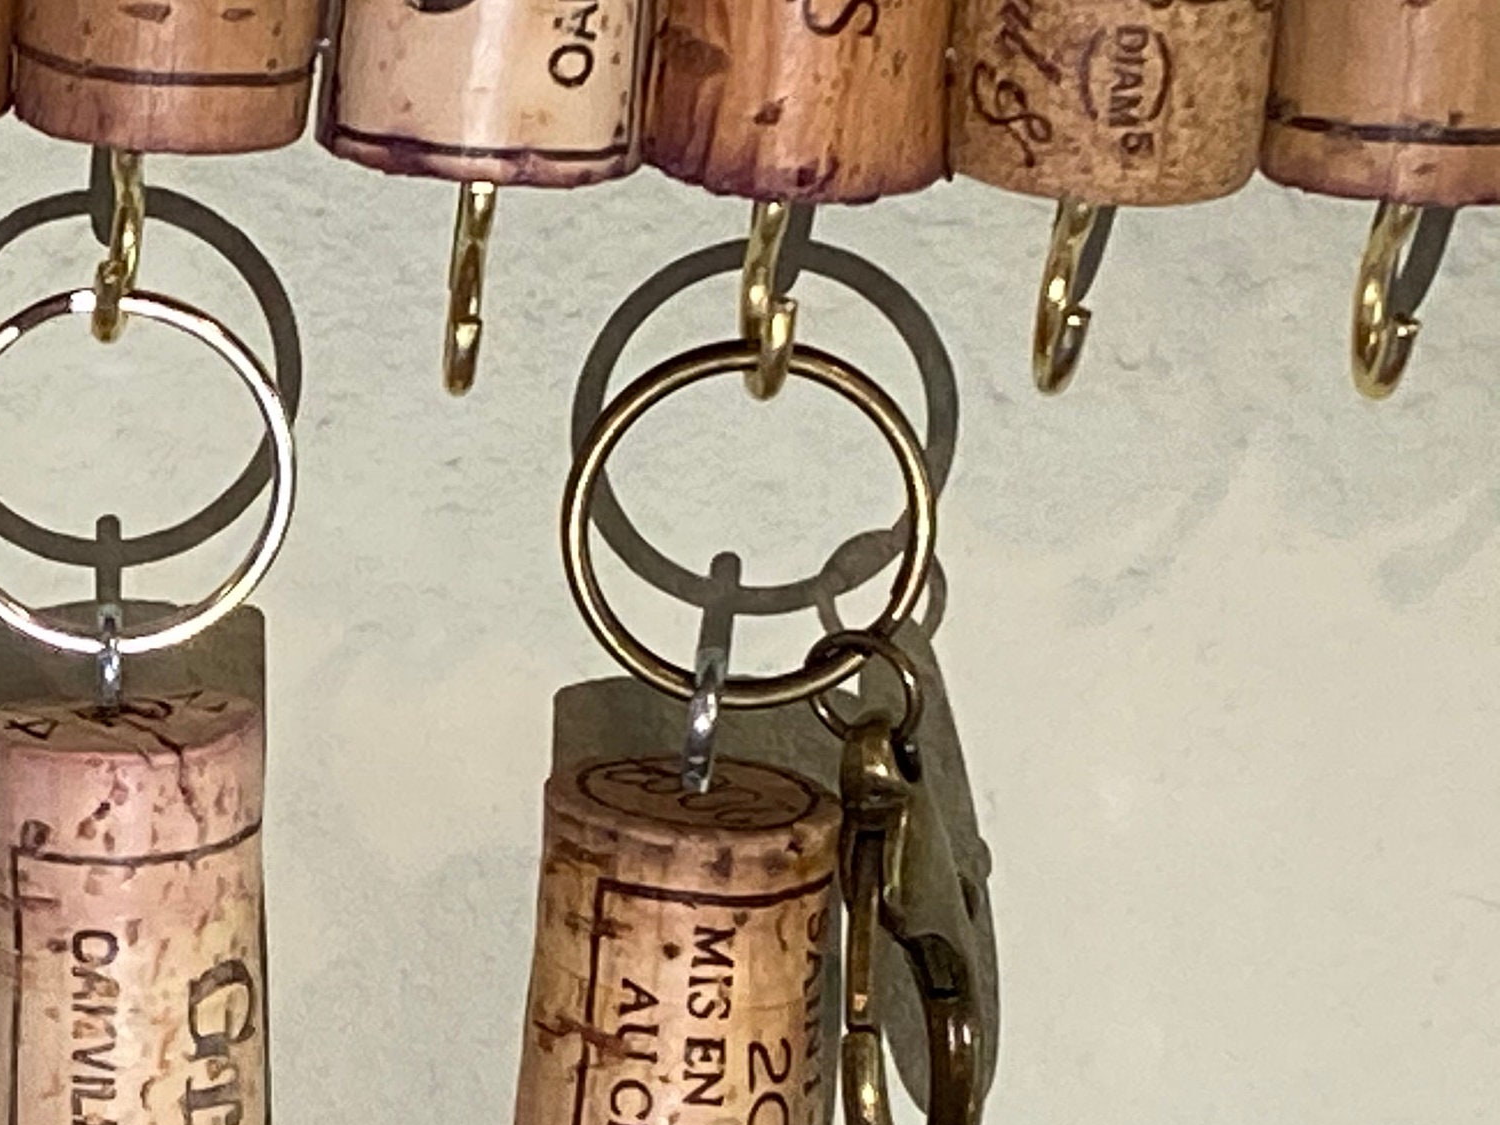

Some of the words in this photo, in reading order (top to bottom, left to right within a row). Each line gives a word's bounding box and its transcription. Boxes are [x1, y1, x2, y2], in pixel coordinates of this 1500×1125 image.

[1108, 24, 1151, 128] DIAM
[686, 924, 737, 1021] MIS
[616, 977, 660, 1065] AU
[682, 1036, 727, 1107] EN
